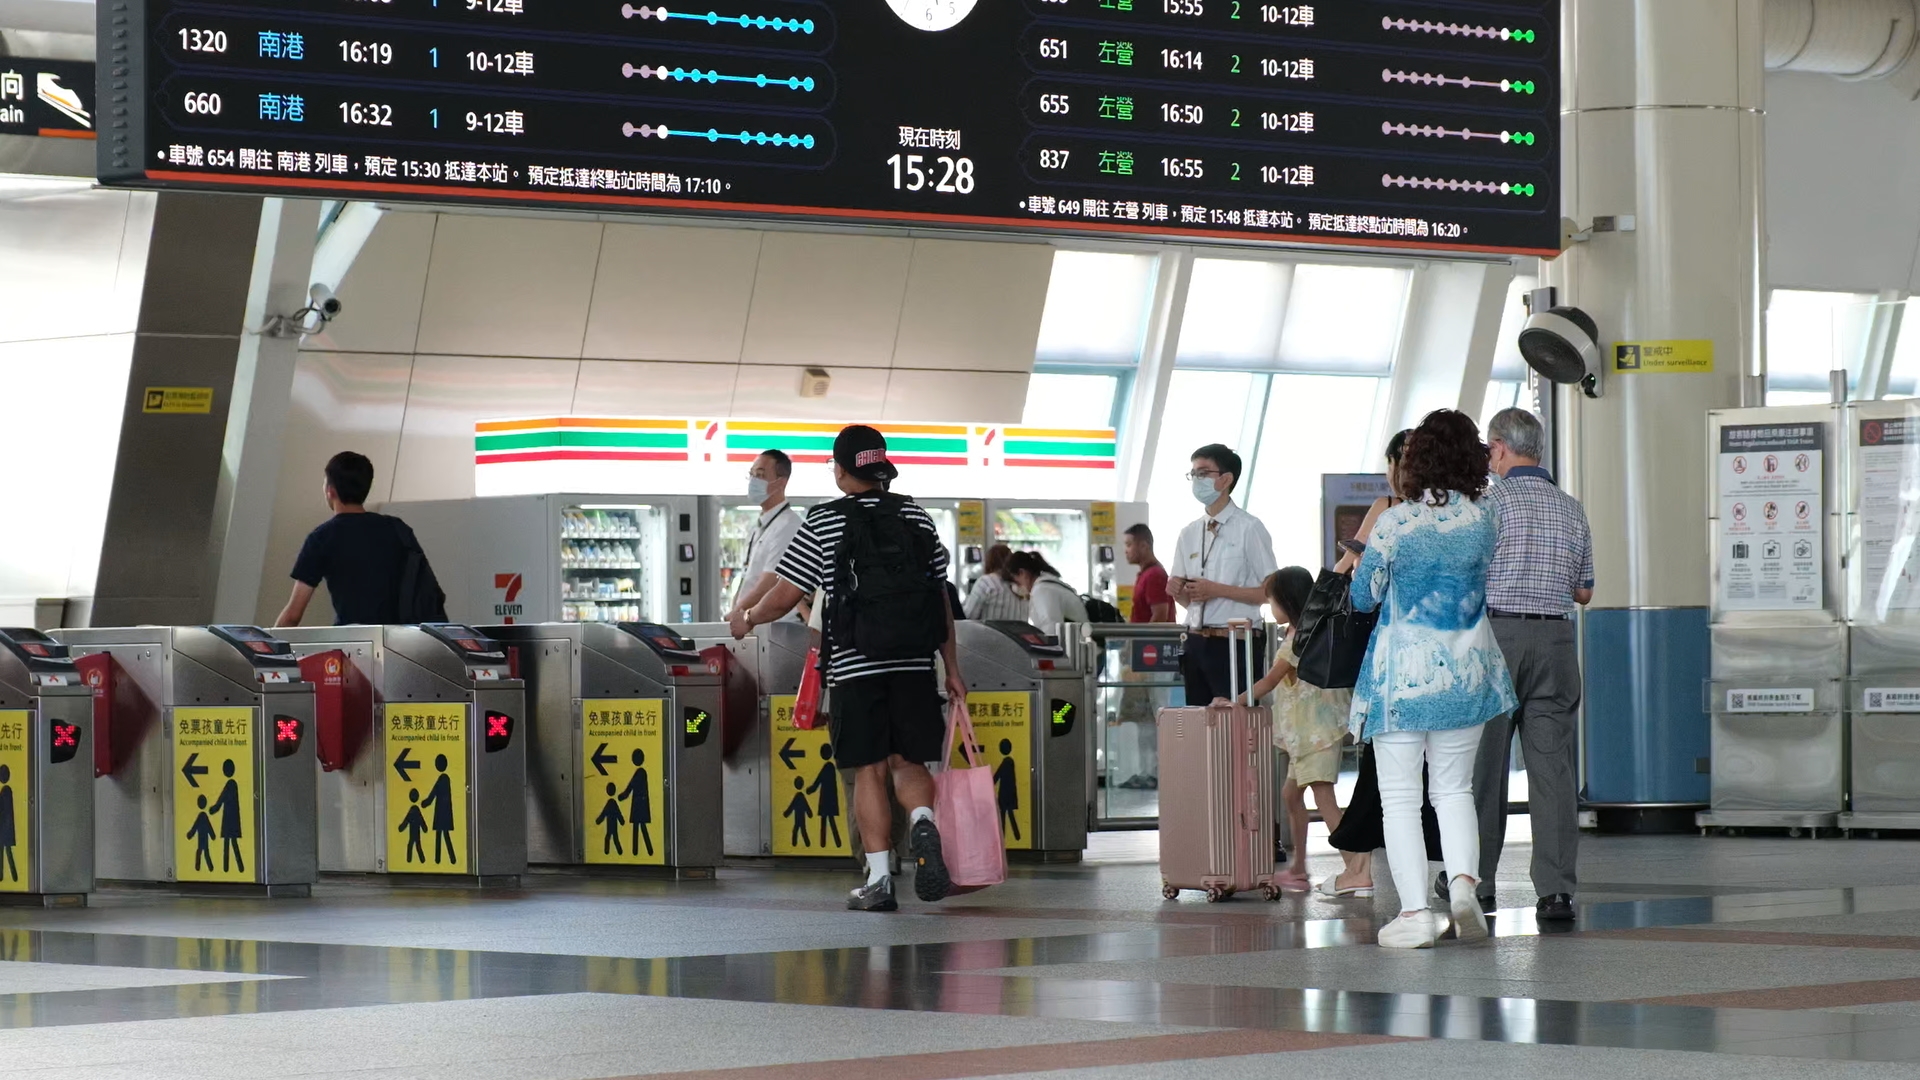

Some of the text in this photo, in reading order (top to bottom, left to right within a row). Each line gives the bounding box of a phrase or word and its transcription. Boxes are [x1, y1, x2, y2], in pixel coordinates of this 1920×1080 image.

[1231, 1, 1240, 19] 2
[1261, 5, 1314, 27] 10-12車
[179, 28, 534, 77] 1320 南港 16:19 1 10-12車
[1039, 39, 1314, 80] 651 左營 16:14 2 10-12車
[1, 69, 23, 100] 向
[184, 92, 524, 136] 660 南港 16:32 1 9-12車
[1039, 94, 1314, 134] 655 左營 16:50 2 10-12車
[899, 126, 960, 150] 現在時刻
[169, 144, 203, 166] 車號
[207, 149, 234, 166] 654
[239, 148, 272, 170] 開往
[277, 151, 310, 172] 南港
[401, 160, 440, 178] 15:30
[528, 165, 681, 193] 預定抵達終點站時間為
[887, 154, 974, 194] 15:28
[1039, 149, 1314, 187] 837 左營 16:55 2 10-12車
[1028, 196, 1055, 214] 車號
[1058, 200, 1080, 214] 649
[1083, 199, 1109, 218] 開往
[1113, 201, 1139, 219] 左營
[1210, 209, 1240, 224] 15:48
[1308, 212, 1428, 237] 預定抵達終點站時間為
[179, 718, 247, 736] 免票孩童先行
[391, 714, 460, 731] 免票孩童先行
[588, 711, 657, 727] 免票孩童先行
[589, 729, 622, 738] Accompanied
[624, 728, 637, 736] child
[644, 728, 657, 736] front
[180, 738, 213, 747] Accompanied
[391, 733, 426, 742] Accompanied
[427, 733, 440, 742] child
[447, 733, 460, 741] front
